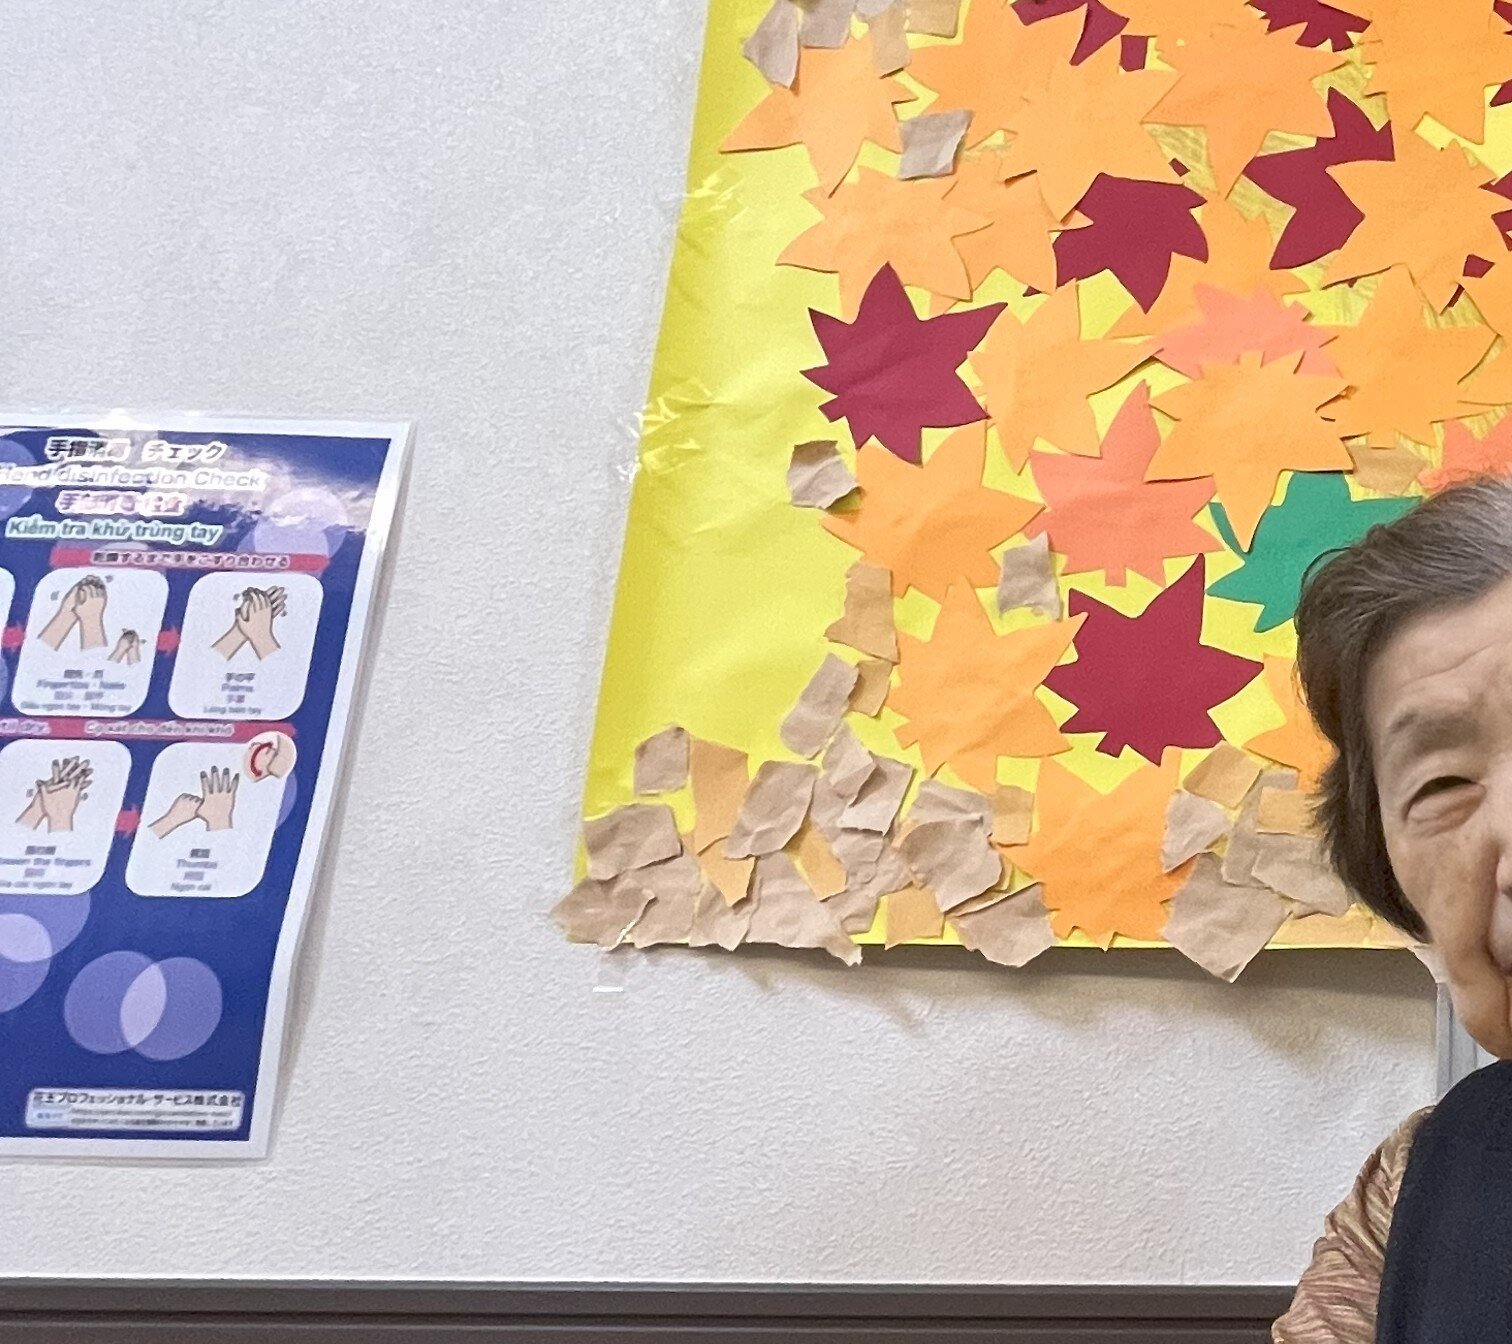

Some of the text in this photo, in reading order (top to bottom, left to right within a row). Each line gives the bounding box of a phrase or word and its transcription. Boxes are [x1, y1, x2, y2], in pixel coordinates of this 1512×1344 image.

[146, 443, 223, 459] チェック
[58, 466, 188, 485] disinfection
[194, 471, 261, 488] Check
[61, 522, 87, 536] tra
[135, 522, 185, 542] trùng
[190, 525, 221, 542] tay
